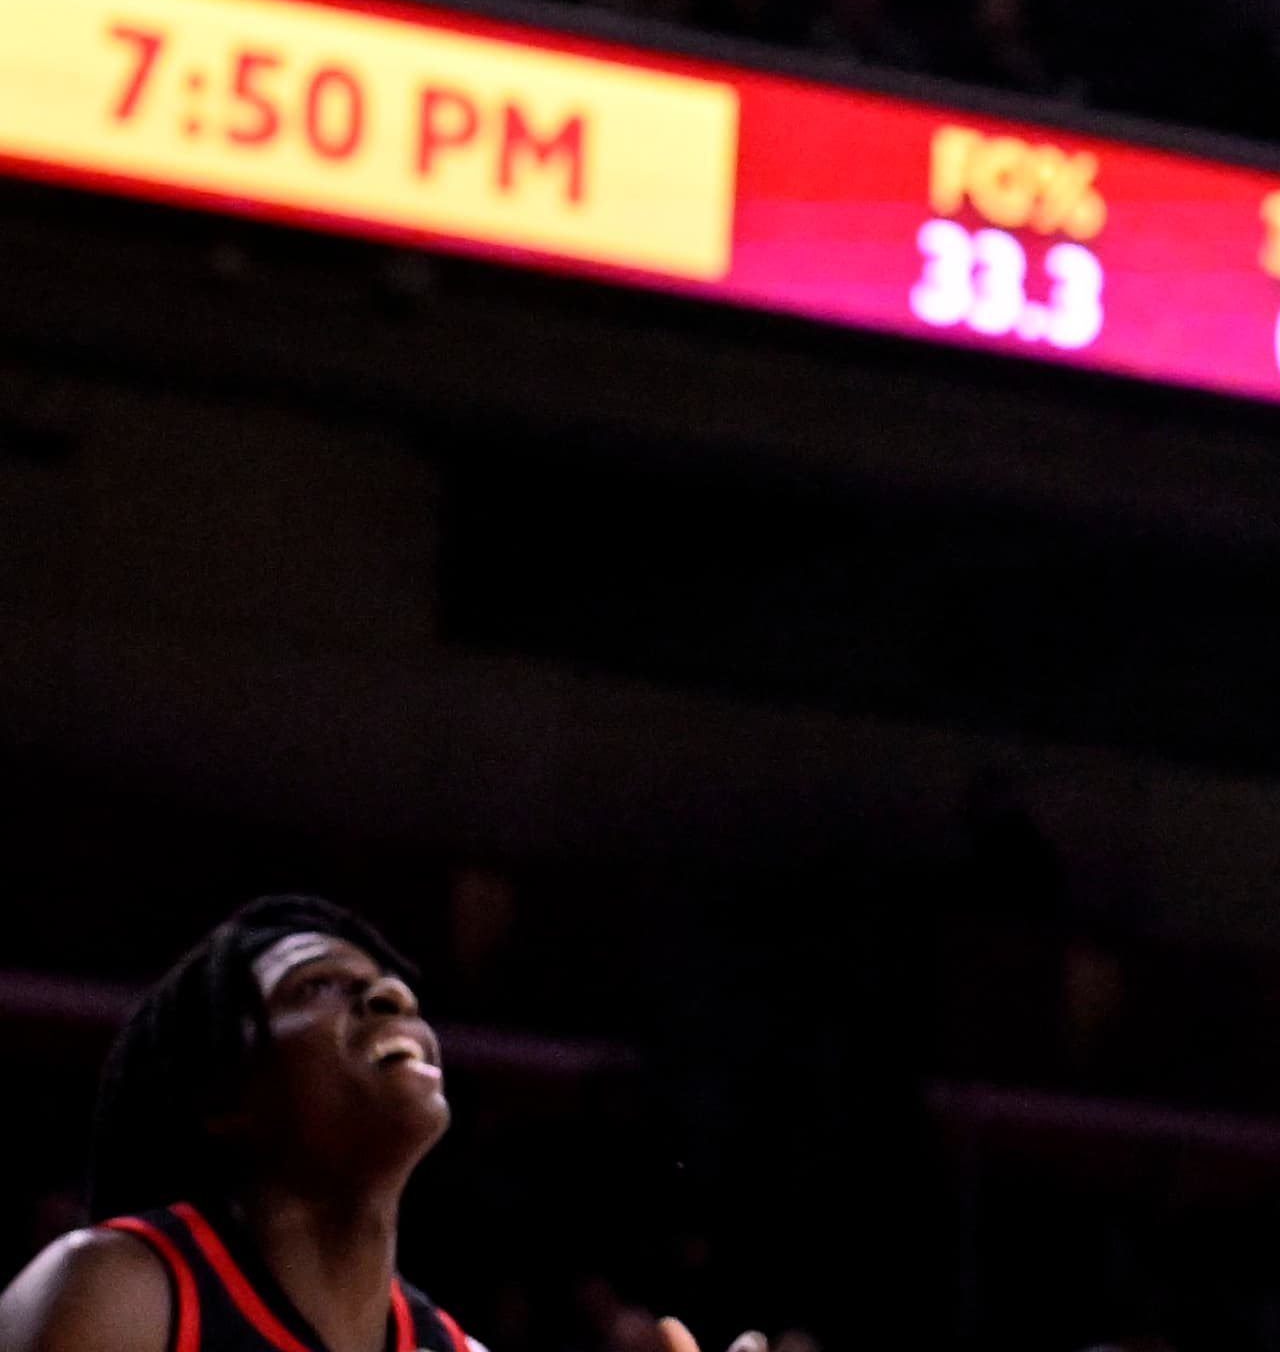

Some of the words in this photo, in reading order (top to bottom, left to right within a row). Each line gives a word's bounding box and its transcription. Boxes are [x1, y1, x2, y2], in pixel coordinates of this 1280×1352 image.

[105, 24, 364, 162] 7:50
[415, 84, 586, 206] PM
[930, 124, 1106, 240] FG%
[909, 219, 1104, 349] 33.3
